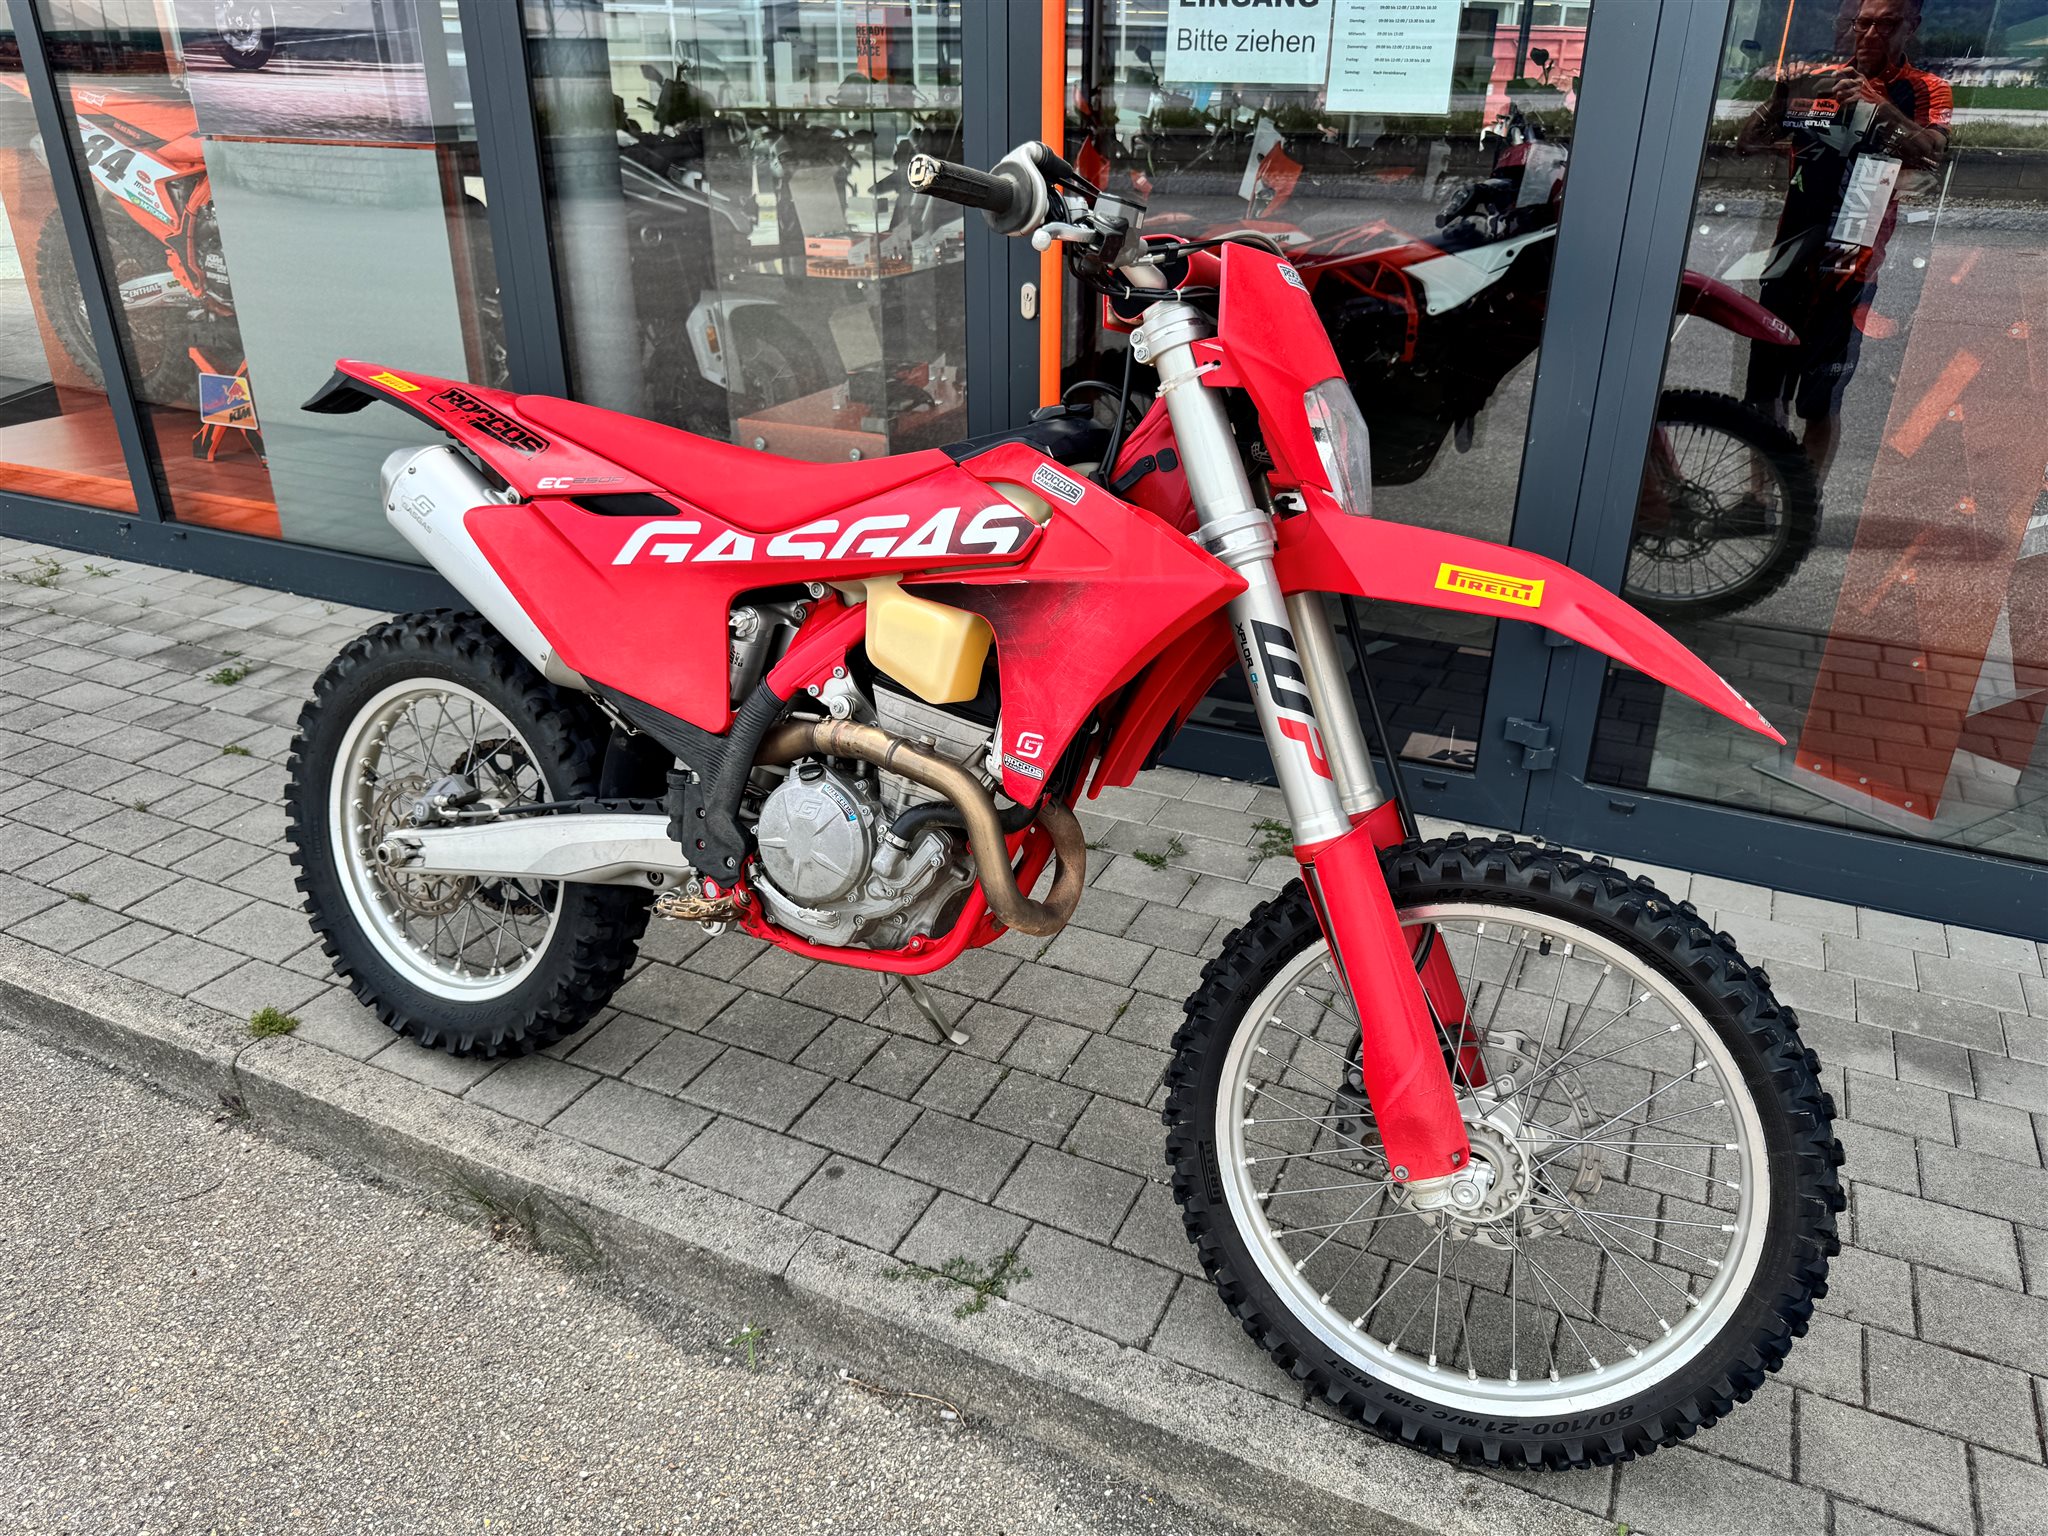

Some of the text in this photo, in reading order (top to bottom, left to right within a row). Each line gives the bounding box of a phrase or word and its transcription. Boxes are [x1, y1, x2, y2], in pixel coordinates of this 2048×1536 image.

[1177, 28, 1315, 53] Bitte ziehen
[83, 134, 136, 184] 84
[229, 405, 251, 423] KTM
[439, 389, 542, 453] ROCCOS
[1038, 468, 1080, 499] ROCCOS
[401, 501, 432, 535] GASGAS
[611, 504, 1027, 566] GASGAS
[1446, 569, 1534, 601] PIRELLI
[1235, 622, 1254, 669] XPLOR
[1250, 618, 1334, 782] WP
[1435, 887, 1538, 904] MX32
[1480, 1404, 1634, 1437] 80/100-21
